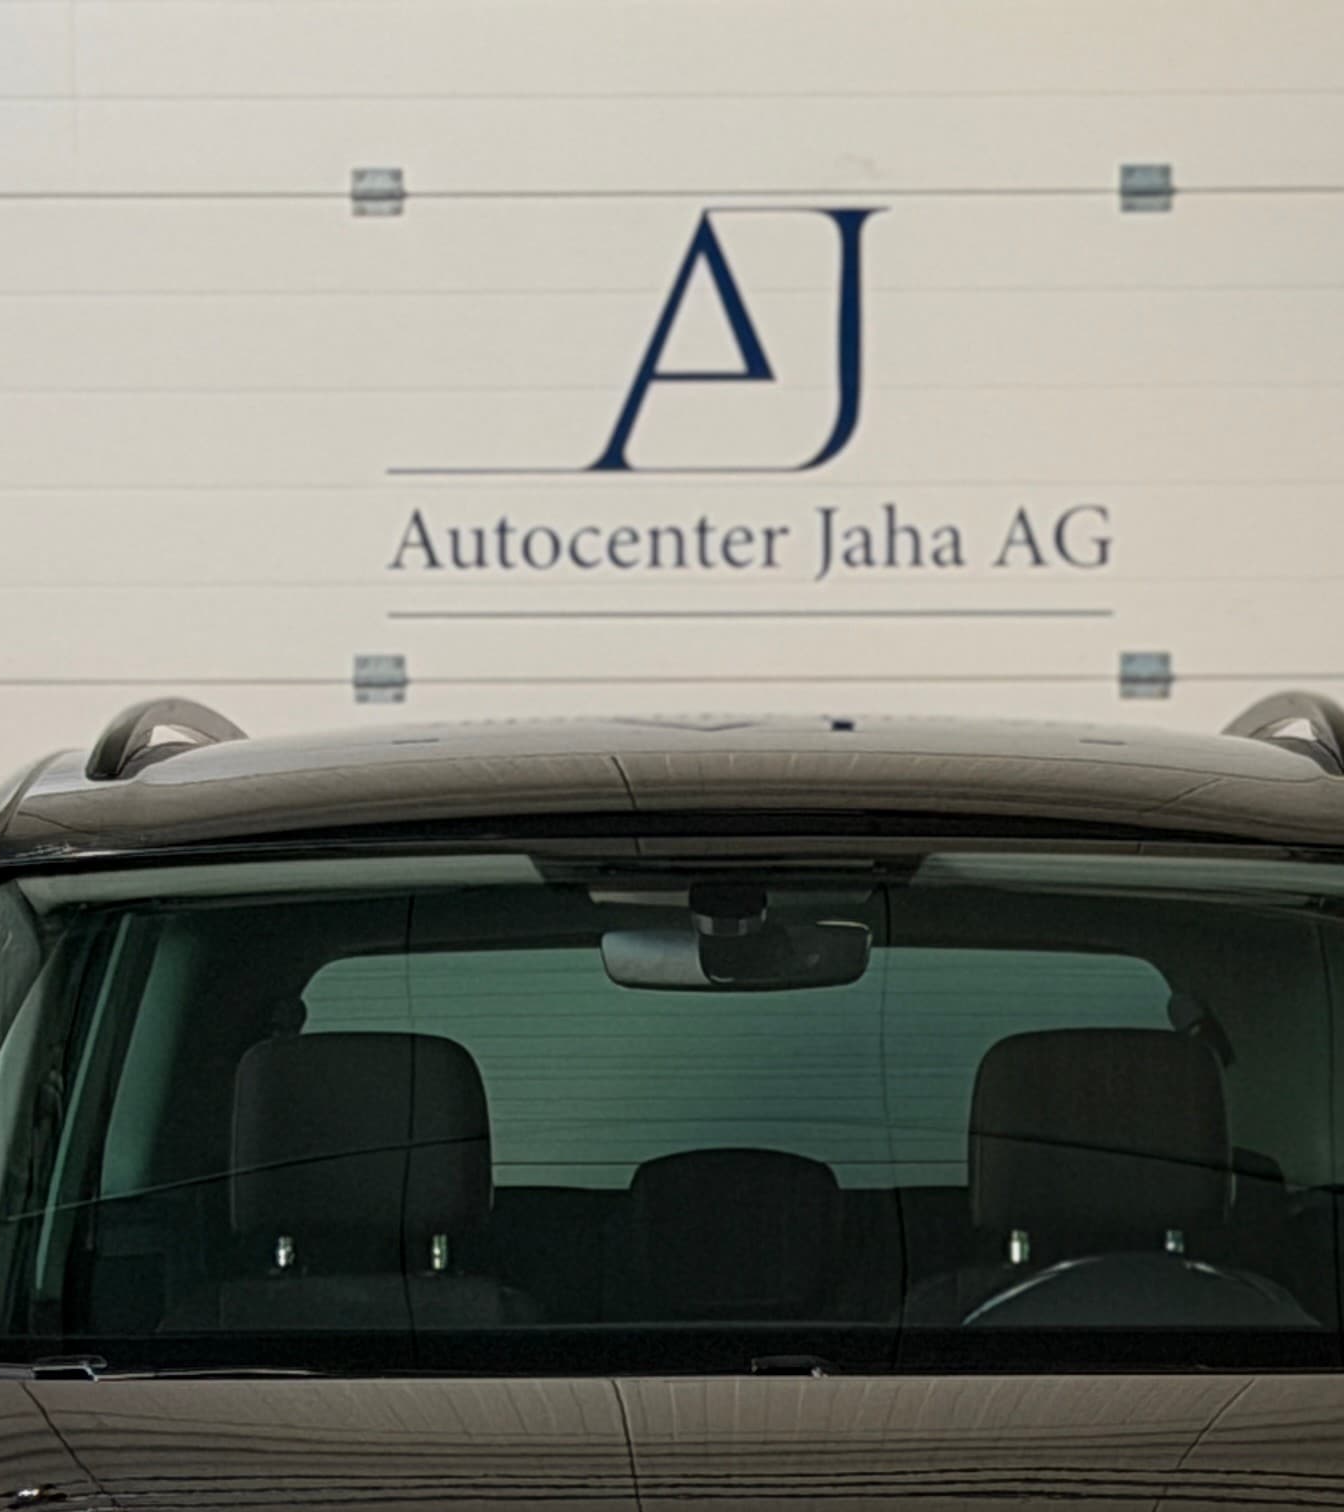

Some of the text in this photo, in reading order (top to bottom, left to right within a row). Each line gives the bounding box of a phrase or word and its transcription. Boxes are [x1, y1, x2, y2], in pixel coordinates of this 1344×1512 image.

[583, 206, 892, 473] AJ
[386, 502, 1114, 581] Autocenter Jaha AG
